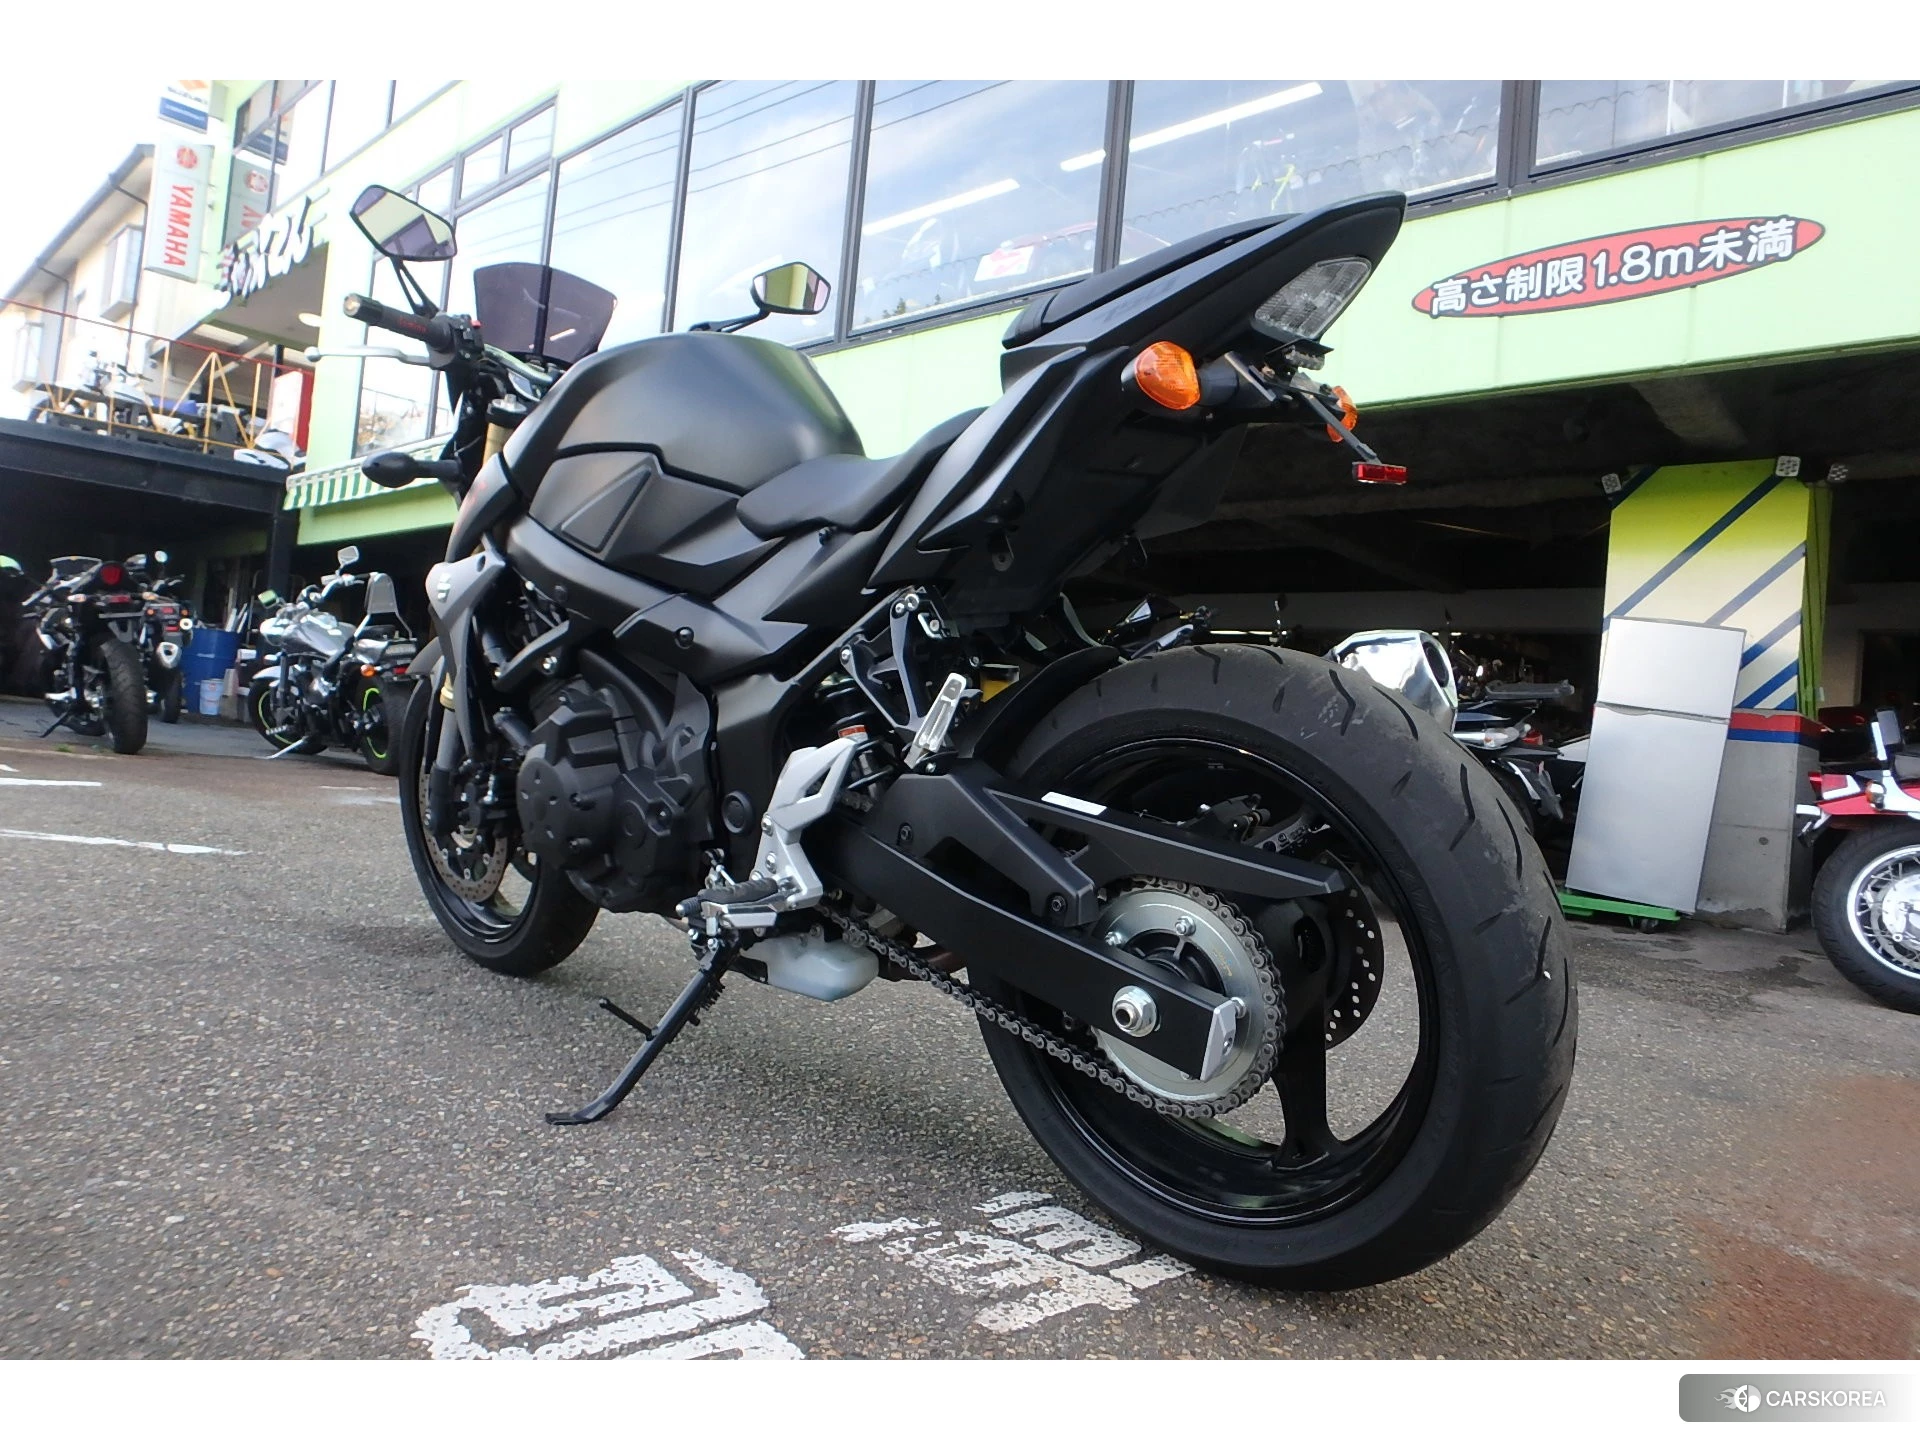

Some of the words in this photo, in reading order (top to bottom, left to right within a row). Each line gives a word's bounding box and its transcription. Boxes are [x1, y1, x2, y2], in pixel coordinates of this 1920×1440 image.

[164, 185, 194, 266] YAMAHA
[1432, 218, 1796, 315] 高さ制限1.8m未満
